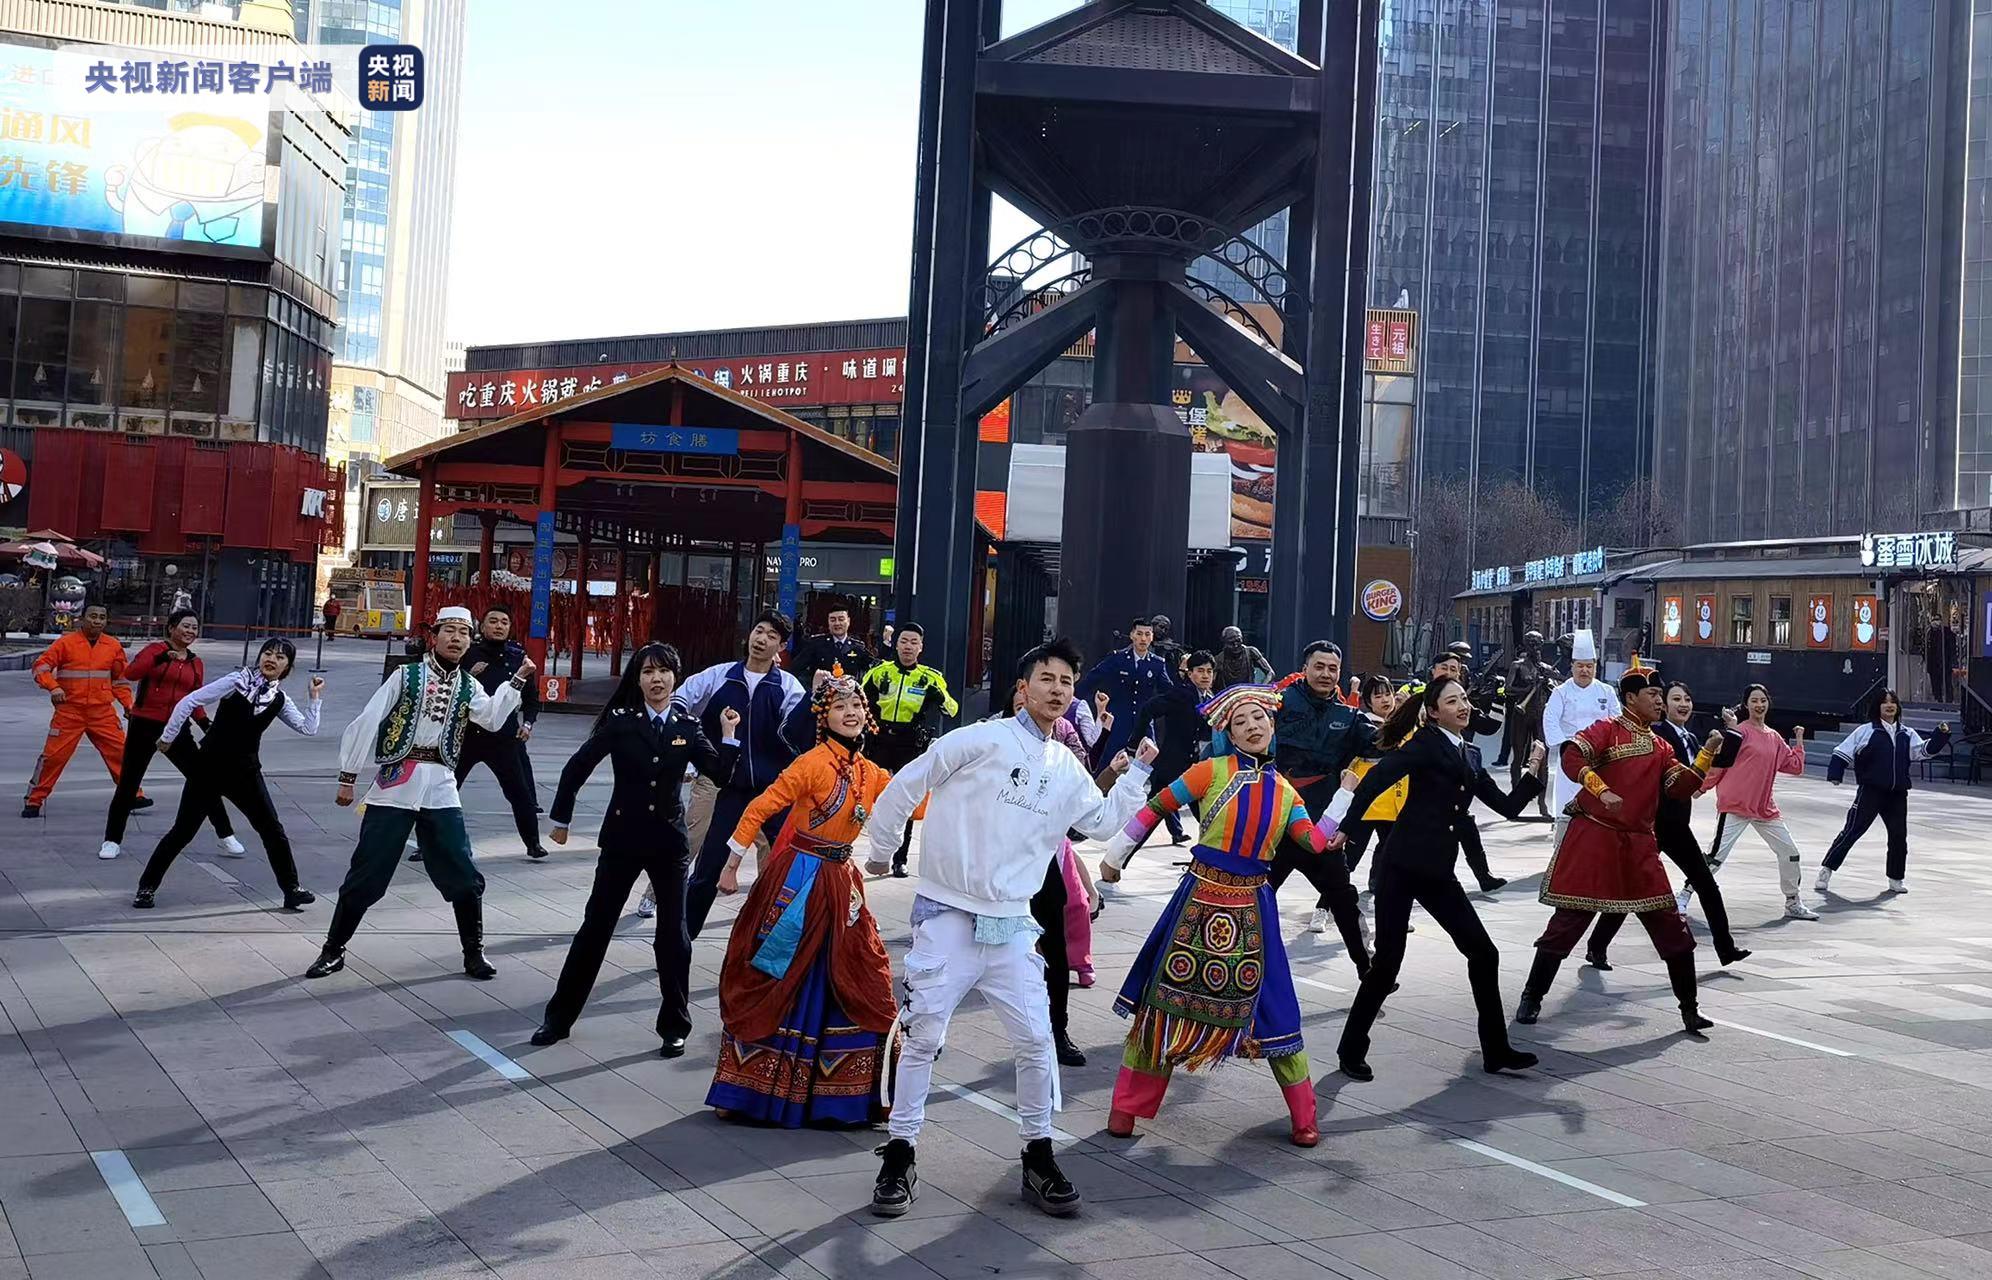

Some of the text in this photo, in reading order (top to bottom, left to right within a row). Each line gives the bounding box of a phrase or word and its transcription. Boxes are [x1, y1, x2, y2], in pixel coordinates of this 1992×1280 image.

[740, 361, 809, 385] 火锅重庆
[1876, 533, 1954, 567] 蜜雪冰城
[799, 557, 818, 567] PRO
[1366, 588, 1397, 602] BURGER
[1367, 595, 1397, 610] KING
